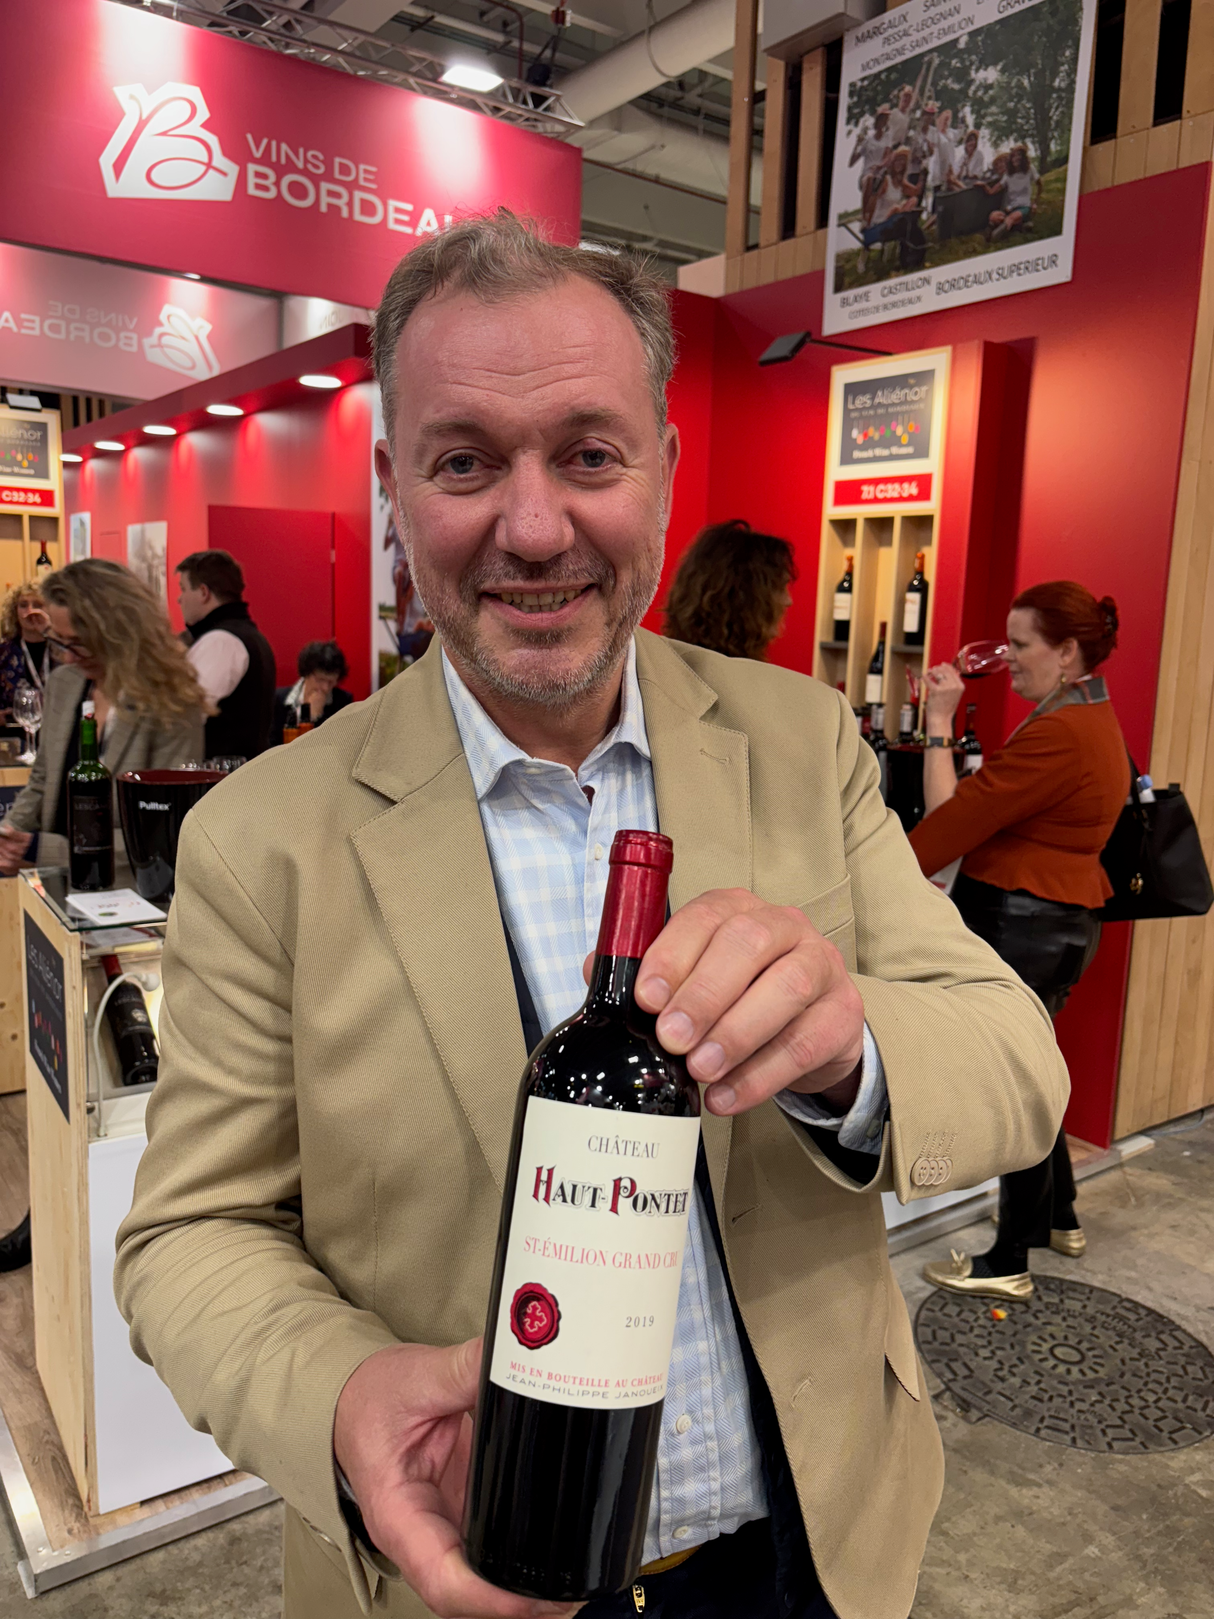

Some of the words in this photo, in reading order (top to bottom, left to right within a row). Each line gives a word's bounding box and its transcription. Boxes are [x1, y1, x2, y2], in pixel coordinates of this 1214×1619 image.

[854, 11, 910, 46] MARGAUX
[881, 3, 961, 48] PESSAC-LEOGNAN
[860, 14, 975, 72] MONTAGNE-SAINT-EMILION
[246, 132, 326, 175] VINS
[333, 156, 378, 189] DE
[880, 274, 932, 298] CASTILLON
[934, 267, 994, 296] BORDEAUX
[994, 253, 1059, 282] SUPERIEUR
[847, 392, 873, 410] Les
[1, 490, 42, 504] C32-34
[139, 801, 170, 811] Pulltex
[587, 1134, 661, 1159] CHÂTEAU
[531, 1164, 690, 1217] HAUT-PONTET
[523, 1235, 609, 1267] ST-ÉMILION
[611, 1251, 661, 1270] GRAND
[625, 1315, 655, 1328] 2019
[505, 1373, 609, 1399] JEAN-PHILIPPE
[614, 1384, 664, 1399] JANOUEIX
[510, 1360, 526, 1374] MIS
[529, 1367, 543, 1378] EN
[546, 1371, 610, 1388] BOUTEILLE
[614, 1379, 627, 1388] AU
[630, 1372, 664, 1388] CHÂTEAU
